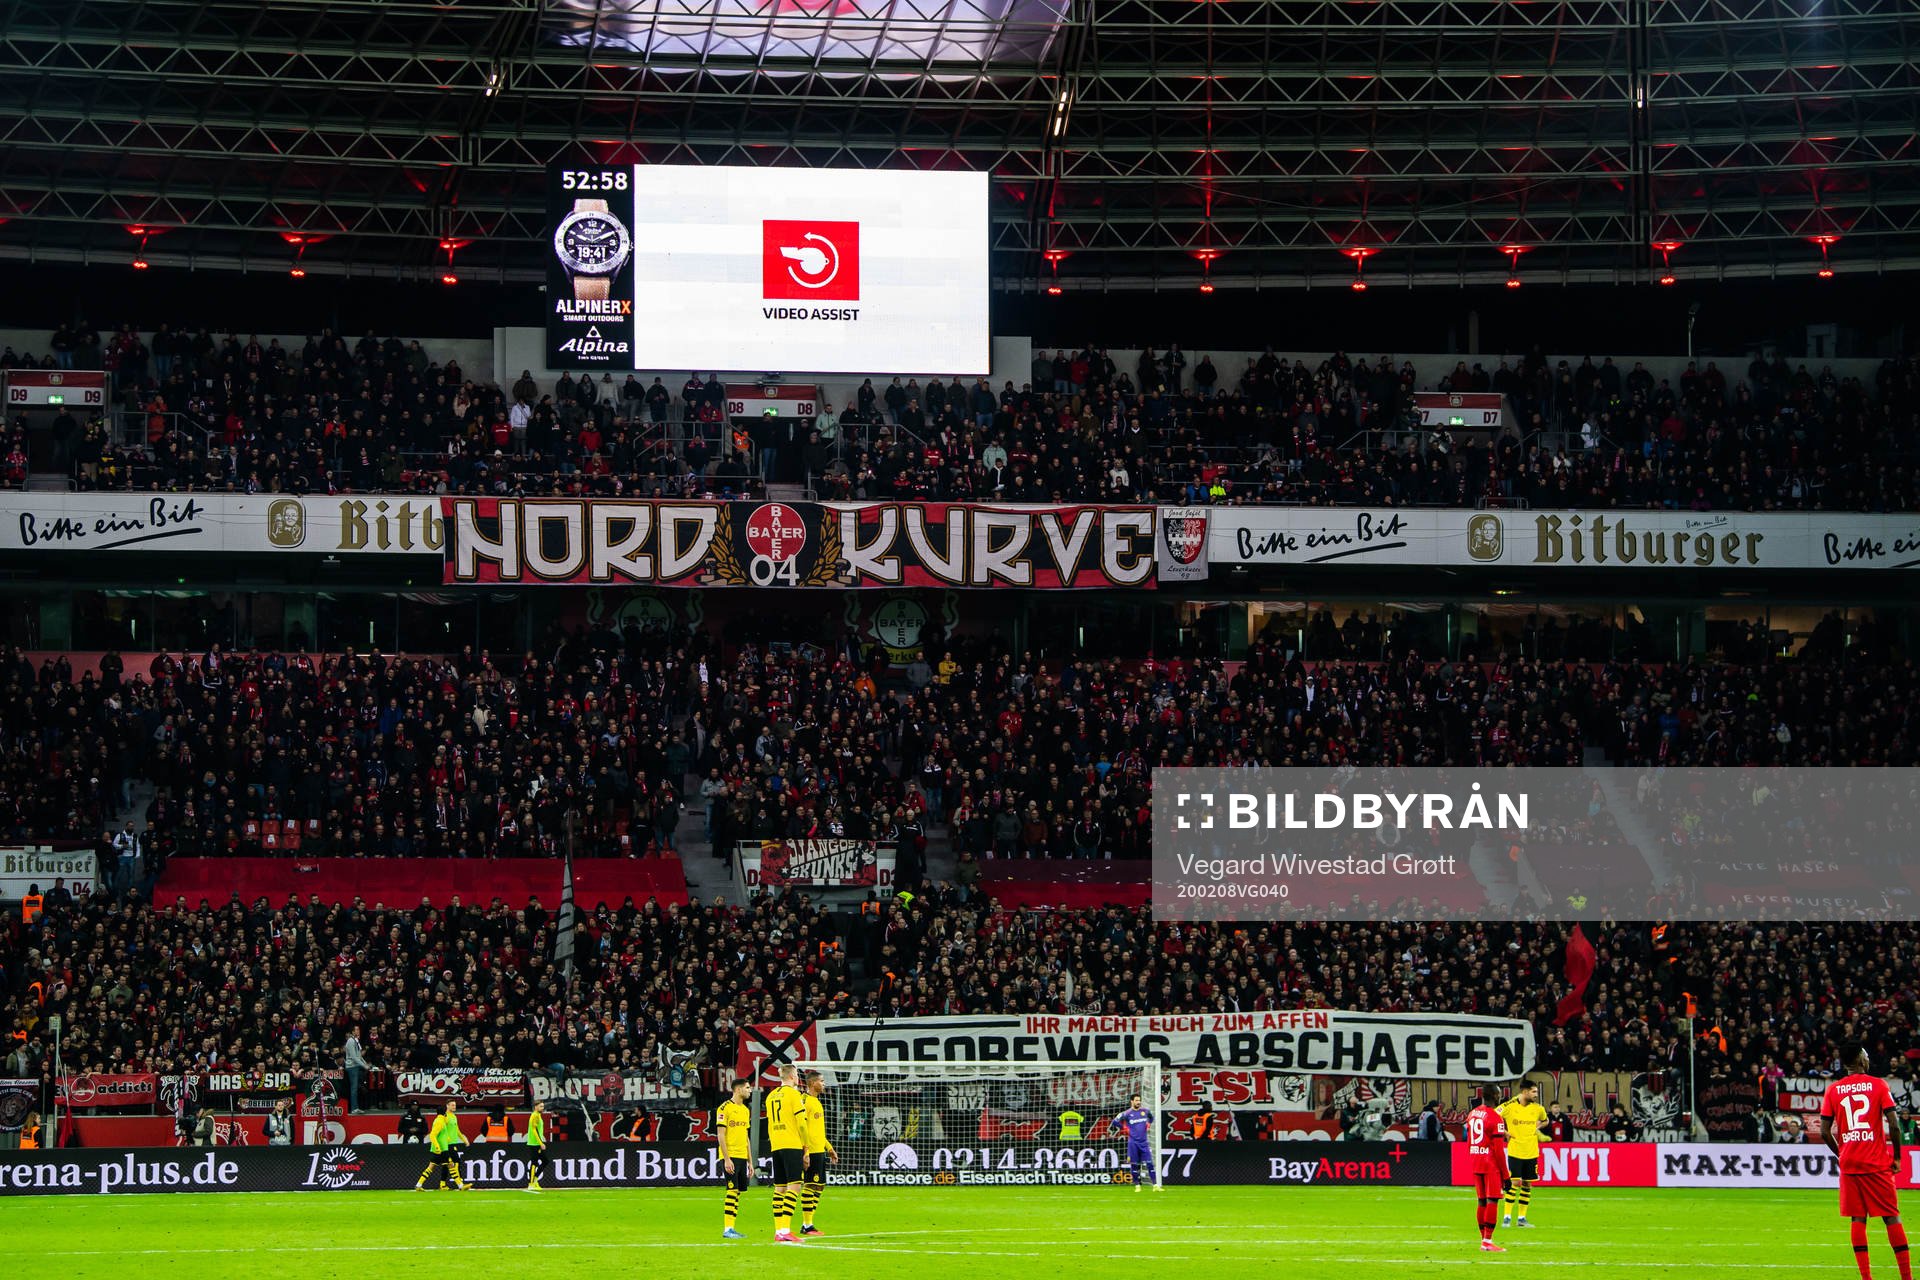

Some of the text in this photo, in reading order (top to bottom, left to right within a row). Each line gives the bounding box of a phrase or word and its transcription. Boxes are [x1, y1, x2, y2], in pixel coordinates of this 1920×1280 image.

[563, 171, 628, 190] 52:58
[556, 299, 632, 314] ALPINERX
[762, 307, 860, 321] VIDEO ASSIST
[559, 338, 629, 355] Alpina
[11, 389, 28, 401] D9
[84, 390, 101, 403] D9
[728, 402, 744, 413] D8
[797, 403, 813, 415] D8
[1483, 411, 1498, 424] D7
[19, 498, 204, 546] Bitte ein Bit
[748, 526, 803, 539] BAYER
[1236, 512, 1408, 559] Bitte ein Bit
[1533, 513, 1764, 566] Bitburger
[839, 506, 1154, 586] KURVE
[1823, 533, 1886, 565] Bitte
[750, 554, 800, 587] 04
[5, 854, 92, 873] Bitburger
[1719, 862, 1840, 873] ALTE HASEN
[1026, 1012, 1329, 1034] IHR MACHT EUCH ZUM AFFEN
[1193, 1031, 1525, 1078] ABSCHAFFEN
[98, 1081, 153, 1094] addicts
[209, 1074, 242, 1091] HAS
[397, 1073, 460, 1094] CHAOS
[1836, 1083, 1872, 1094] TAPSOBA
[771, 1100, 782, 1122] 17
[1840, 1094, 1870, 1131] 12
[1469, 1117, 1484, 1145] 19
[1861, 1131, 1874, 1142] 04
[553, 1148, 632, 1182] und
[637, 1149, 775, 1181] Buchn
[1540, 1146, 1611, 1182] NTI
[959, 1169, 1046, 1185] Eisenbach
[1047, 1169, 1134, 1185] Tresore.de
